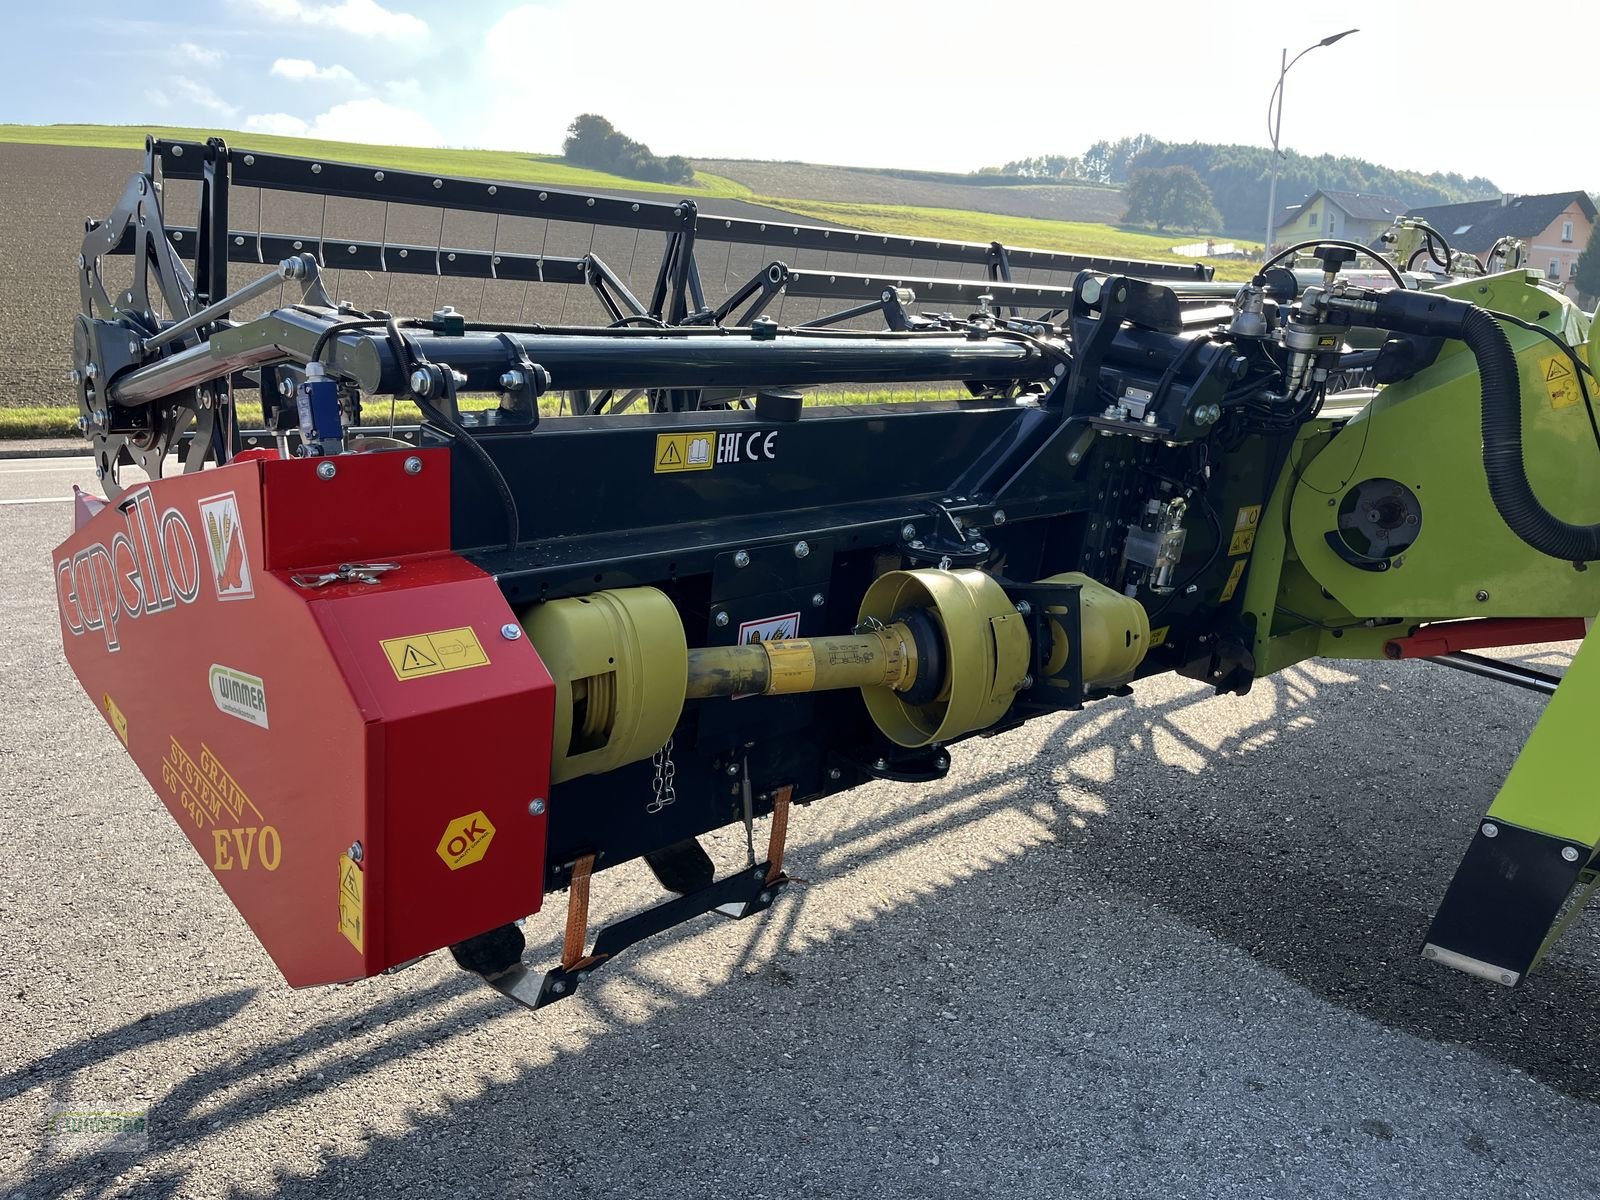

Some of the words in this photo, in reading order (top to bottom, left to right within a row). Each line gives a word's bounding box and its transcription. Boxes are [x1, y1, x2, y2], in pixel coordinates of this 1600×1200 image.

[717, 433, 742, 463] EAC
[746, 431, 778, 460] CE
[57, 485, 199, 653] capello
[218, 675, 266, 713] WIMMER
[162, 764, 177, 794] GS
[180, 790, 203, 829] 640
[170, 743, 222, 821] SYSTEM
[200, 750, 246, 817] GRAIN
[211, 825, 281, 871] EVO
[446, 818, 488, 857] OK
